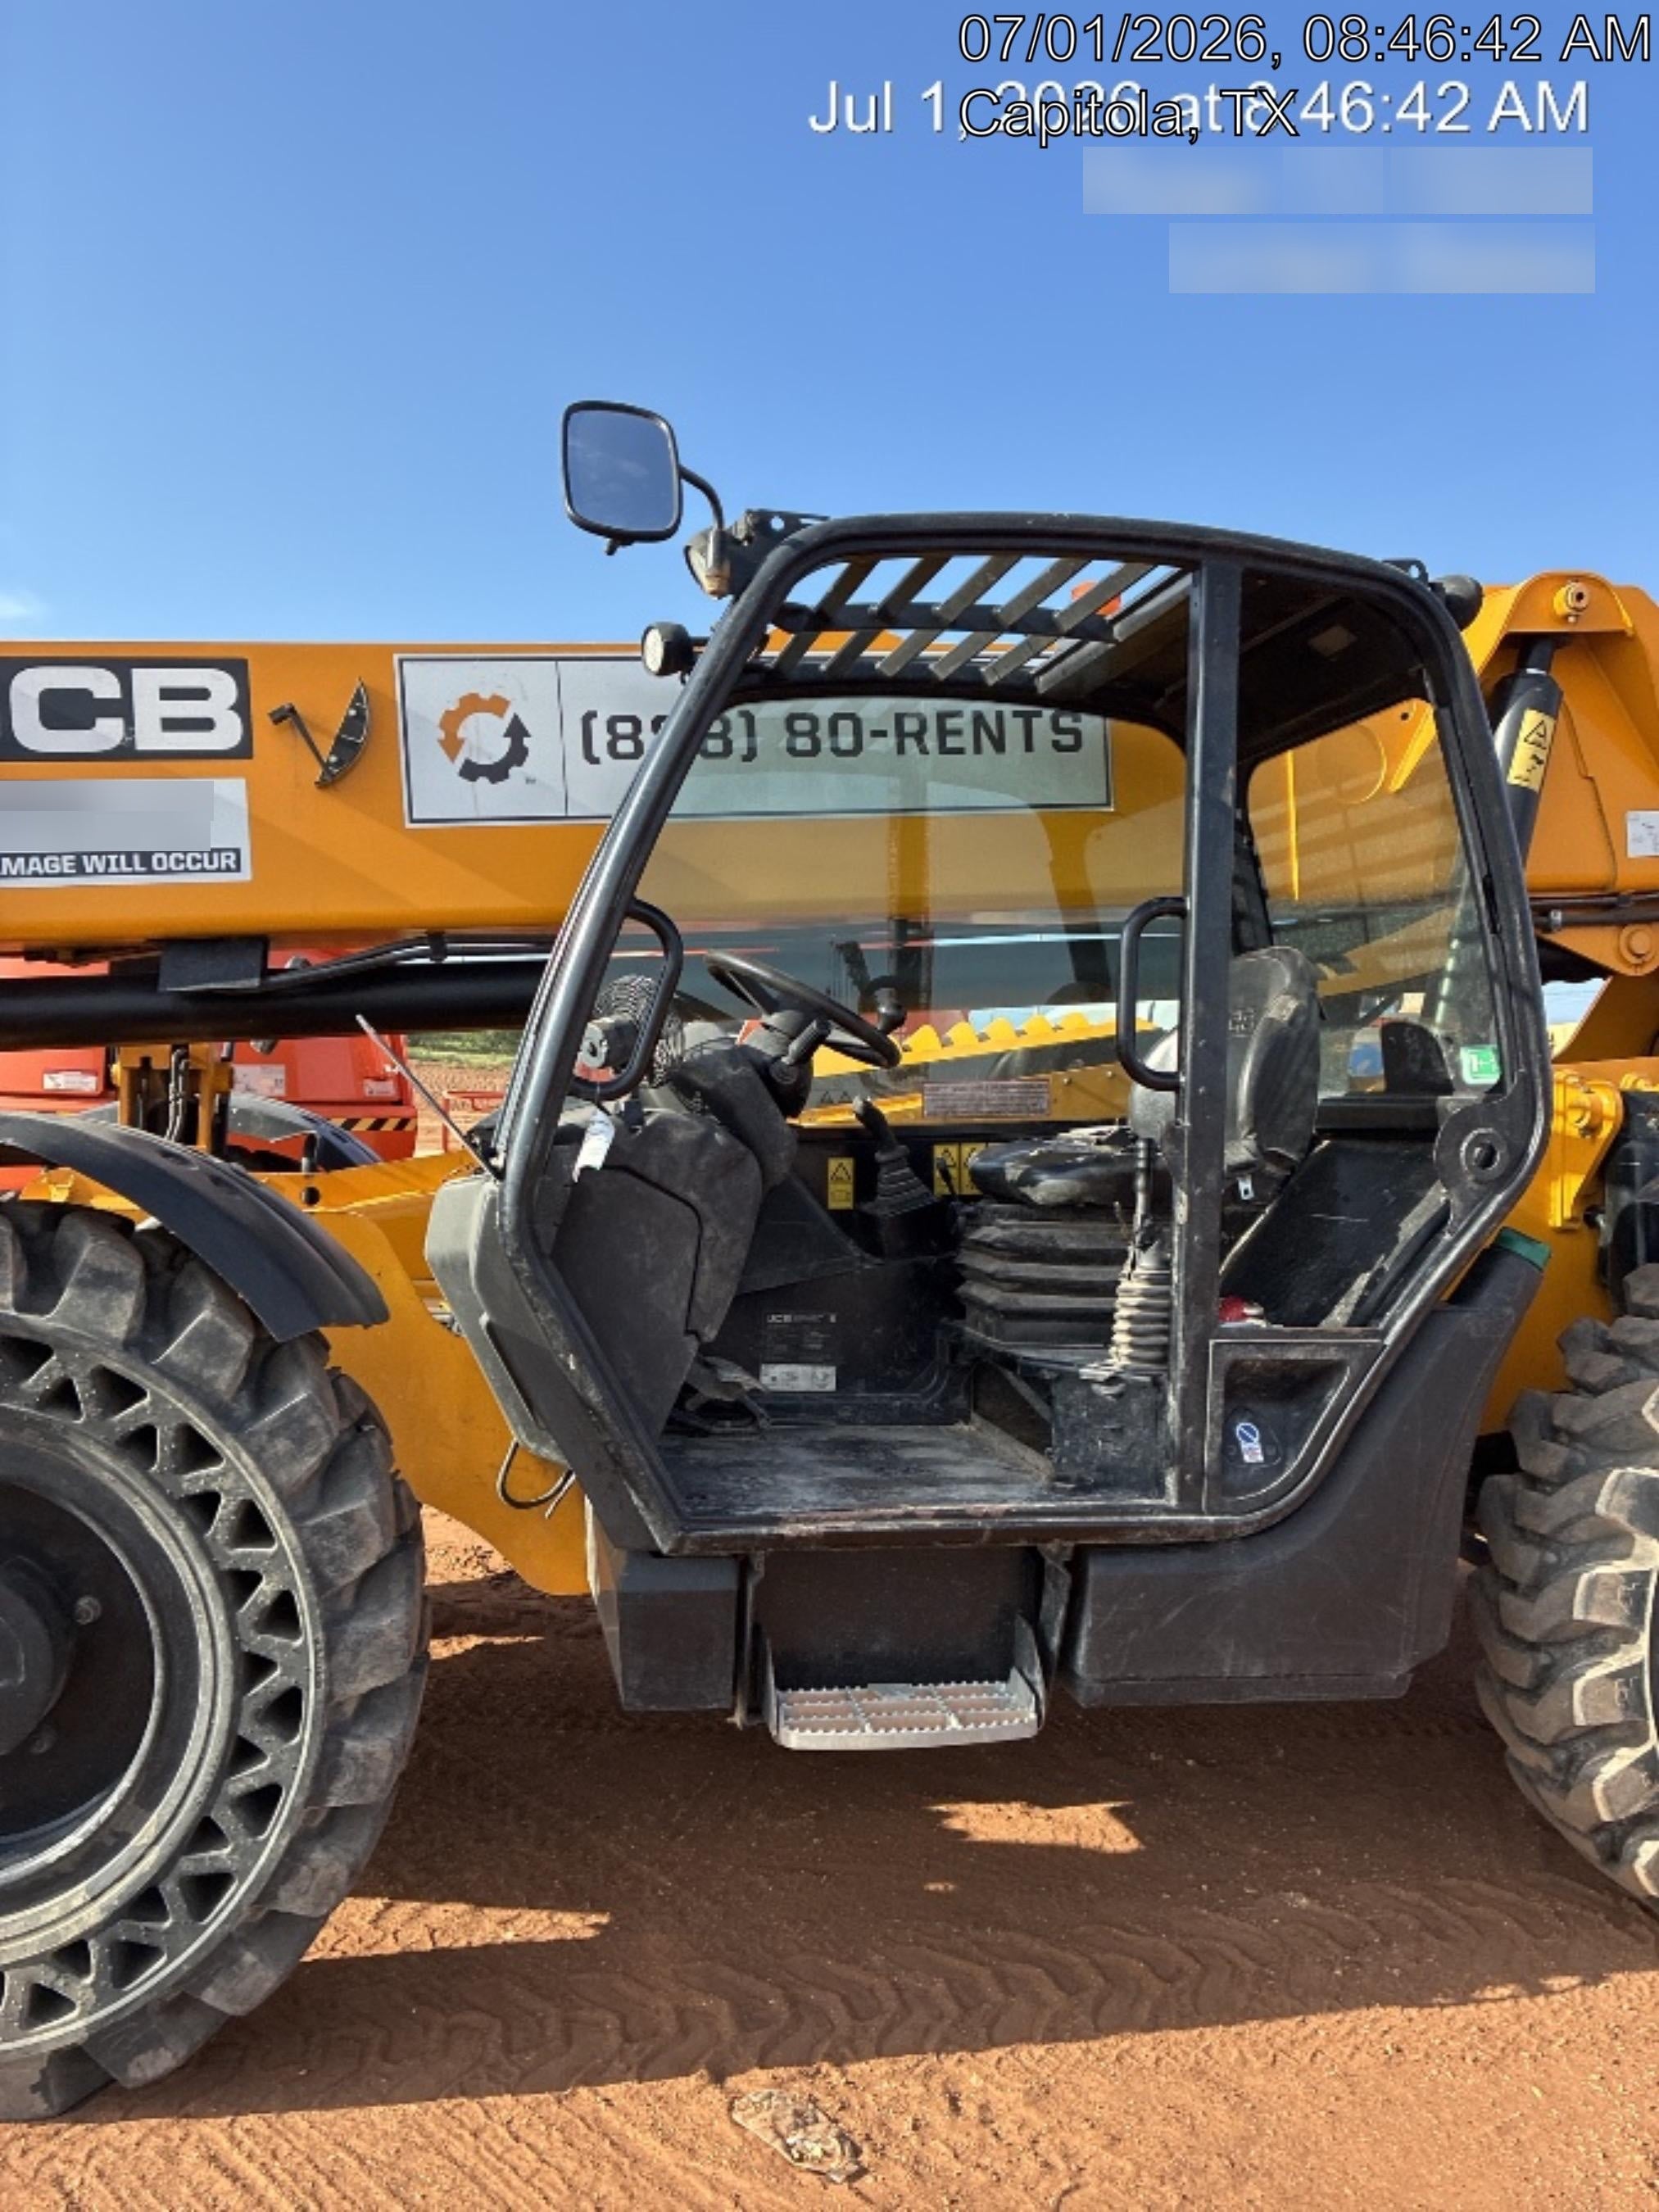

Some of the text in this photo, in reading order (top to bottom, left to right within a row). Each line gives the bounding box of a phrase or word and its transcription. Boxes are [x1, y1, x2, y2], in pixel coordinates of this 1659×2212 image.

[581, 709, 1083, 765] (88) 80-RENTS
[82, 853, 147, 874] WILL
[151, 851, 238, 873] OCCUR
